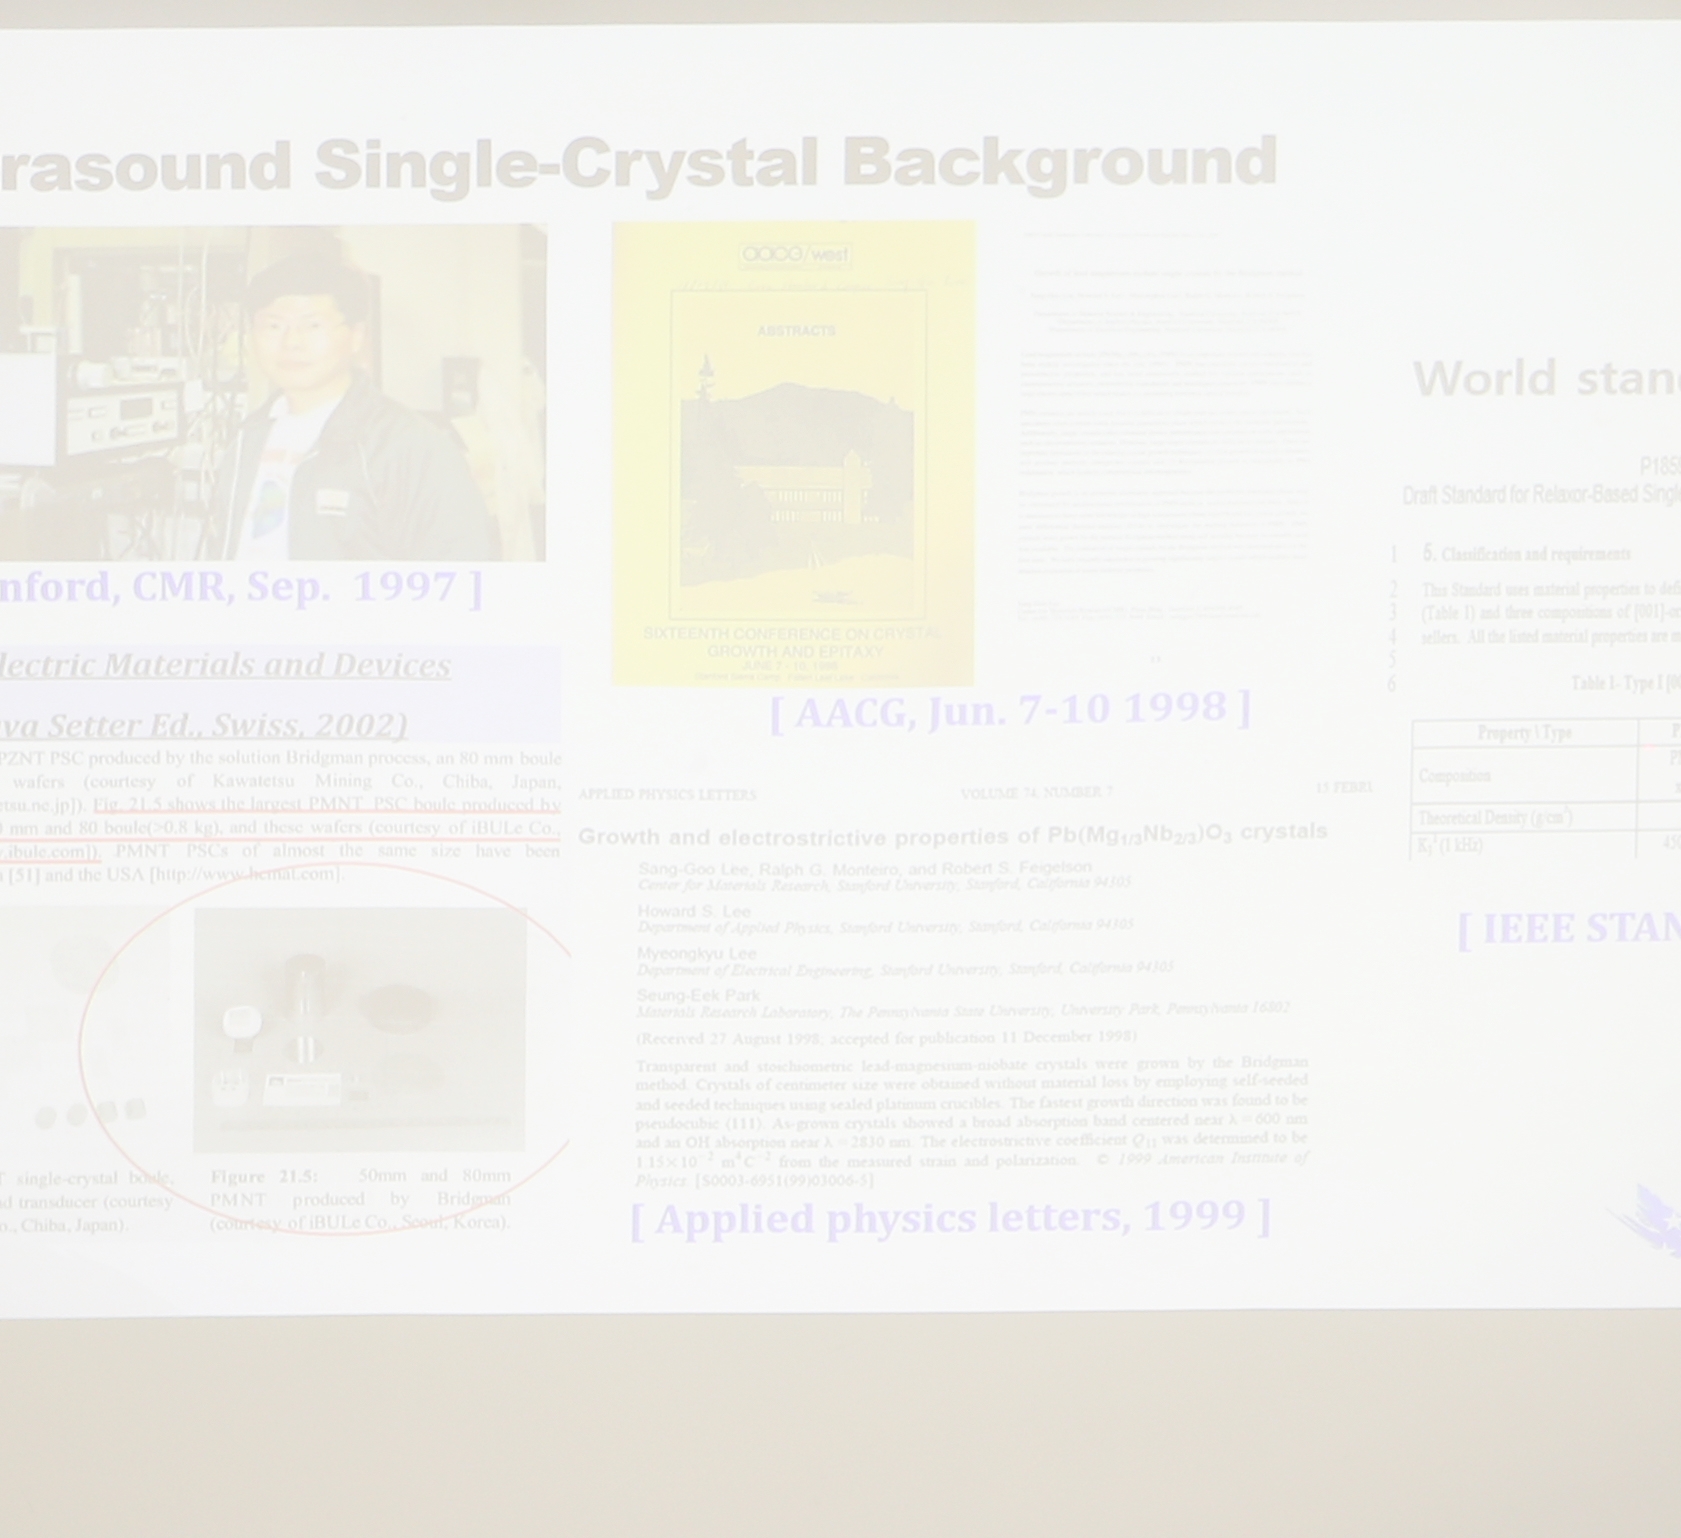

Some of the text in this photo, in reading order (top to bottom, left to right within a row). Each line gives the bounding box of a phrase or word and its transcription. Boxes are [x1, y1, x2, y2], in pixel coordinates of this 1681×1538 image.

[314, 135, 819, 201] Single-Crystal
[843, 134, 1278, 199] Background
[756, 325, 837, 337] ABSTRACTS
[1412, 356, 1558, 398] World
[1402, 484, 1440, 507] Draft
[1440, 483, 1508, 506] Standard
[1509, 483, 1531, 505] for
[132, 570, 236, 607] CMR,
[247, 570, 331, 611] Sep.
[354, 570, 457, 602] 1997
[643, 626, 731, 641] SIXTEENTH
[732, 627, 841, 641] CONFERENCE
[846, 627, 870, 641] ON
[707, 645, 884, 659] GROWTH AND EPITAXY
[105, 651, 256, 680] Materials
[264, 651, 323, 680] and
[333, 651, 453, 680] Devices
[794, 697, 917, 733] AACG,
[927, 696, 1007, 735] Jun.
[1019, 693, 1111, 725] 7-10
[1124, 690, 1227, 723] 1998
[47, 712, 142, 740] Setter
[213, 712, 305, 742] Swiss,
[315, 712, 410, 743] 2002)
[49, 749, 85, 767] PSC
[87, 749, 162, 771] produced
[165, 749, 186, 769] by
[189, 749, 215, 766] the
[217, 749, 282, 766] solution
[285, 748, 364, 769] Bridgman
[435, 754, 456, 766] an
[459, 750, 480, 766] 80
[483, 754, 515, 766] mm
[519, 750, 563, 767] boule
[577, 826, 661, 846] Growth
[668, 827, 711, 847] and
[718, 828, 888, 848] electrostrictive
[894, 827, 1010, 850] properties
[1016, 825, 1041, 845] of
[1239, 821, 1329, 845] crystals
[637, 861, 717, 879] Sang-Goo
[758, 861, 805, 878] Ralph
[907, 862, 938, 877] and
[941, 860, 994, 877] Robert
[1018, 859, 1094, 876] Feigelson
[637, 903, 698, 919] Howard
[722, 903, 752, 920] Lee
[1484, 912, 1576, 944] IEEE
[636, 945, 758, 963] Myeongkyu Lee
[636, 986, 762, 1005] Seung-Eek Park
[654, 1202, 815, 1244] Applied
[826, 1202, 977, 1243] physics
[988, 1201, 1131, 1237] letters,
[1144, 1199, 1246, 1231] 1999
